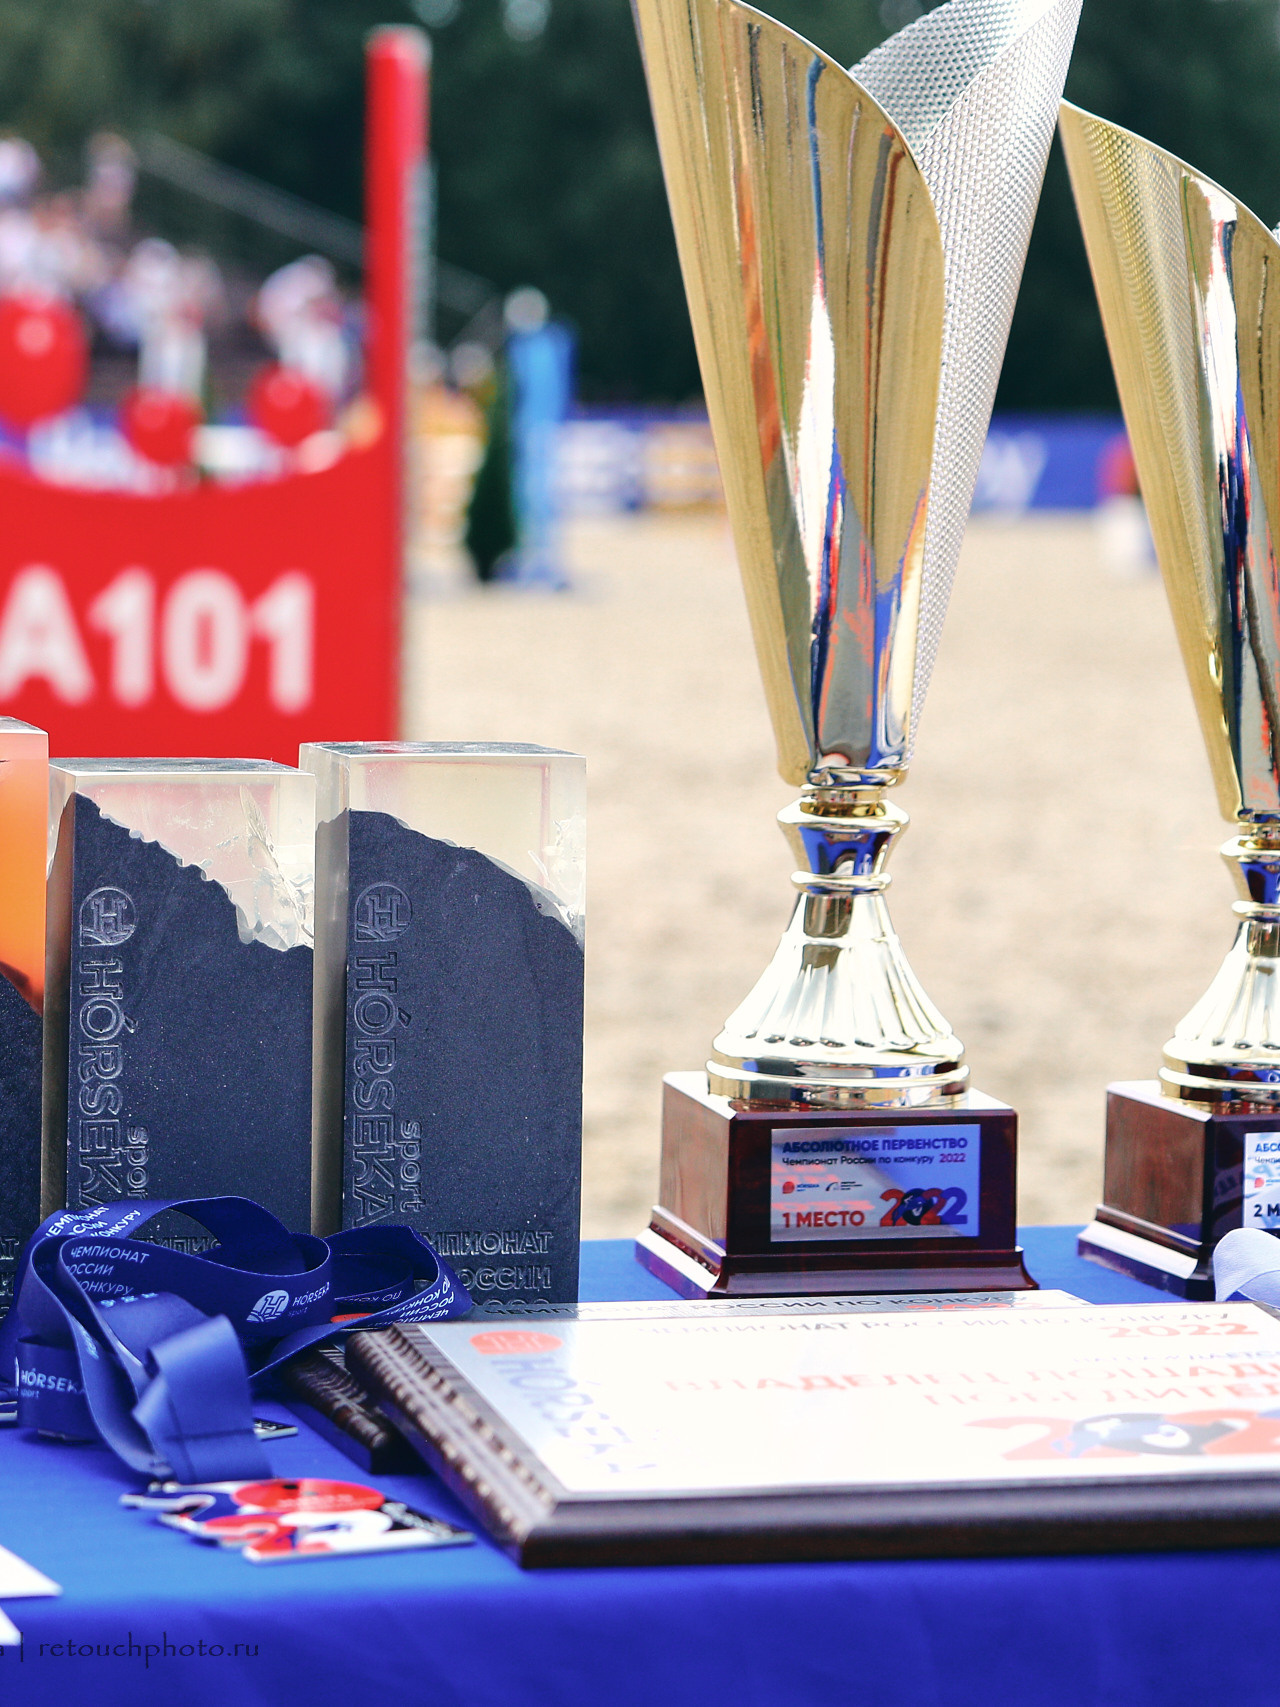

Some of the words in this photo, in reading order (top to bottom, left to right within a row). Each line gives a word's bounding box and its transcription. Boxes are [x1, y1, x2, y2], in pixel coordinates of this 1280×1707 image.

[782, 1139, 880, 1154] АБСОЛЮТНОЕ
[882, 1137, 968, 1151] ПЕРВЕНСТВО
[124, 1124, 150, 1200] spor
[400, 1119, 426, 1213] sport
[782, 1156, 838, 1166] Чемпионат
[841, 1155, 876, 1165] России
[879, 1156, 891, 1164] по
[893, 1155, 934, 1165] конкуру
[939, 1152, 966, 1163] 2022
[782, 1213, 790, 1228] 1
[796, 1210, 865, 1228] МЕСТО
[1254, 1204, 1262, 1217] 2
[70, 1245, 150, 1264] ЧЕМПИОНАТ
[456, 1265, 552, 1291] ОССИИ
[78, 1280, 134, 1296] ОНКУРУ
[691, 1301, 827, 1310] РОССИИ
[833, 1298, 881, 1306] ПО
[1099, 1322, 1260, 1339] 2022
